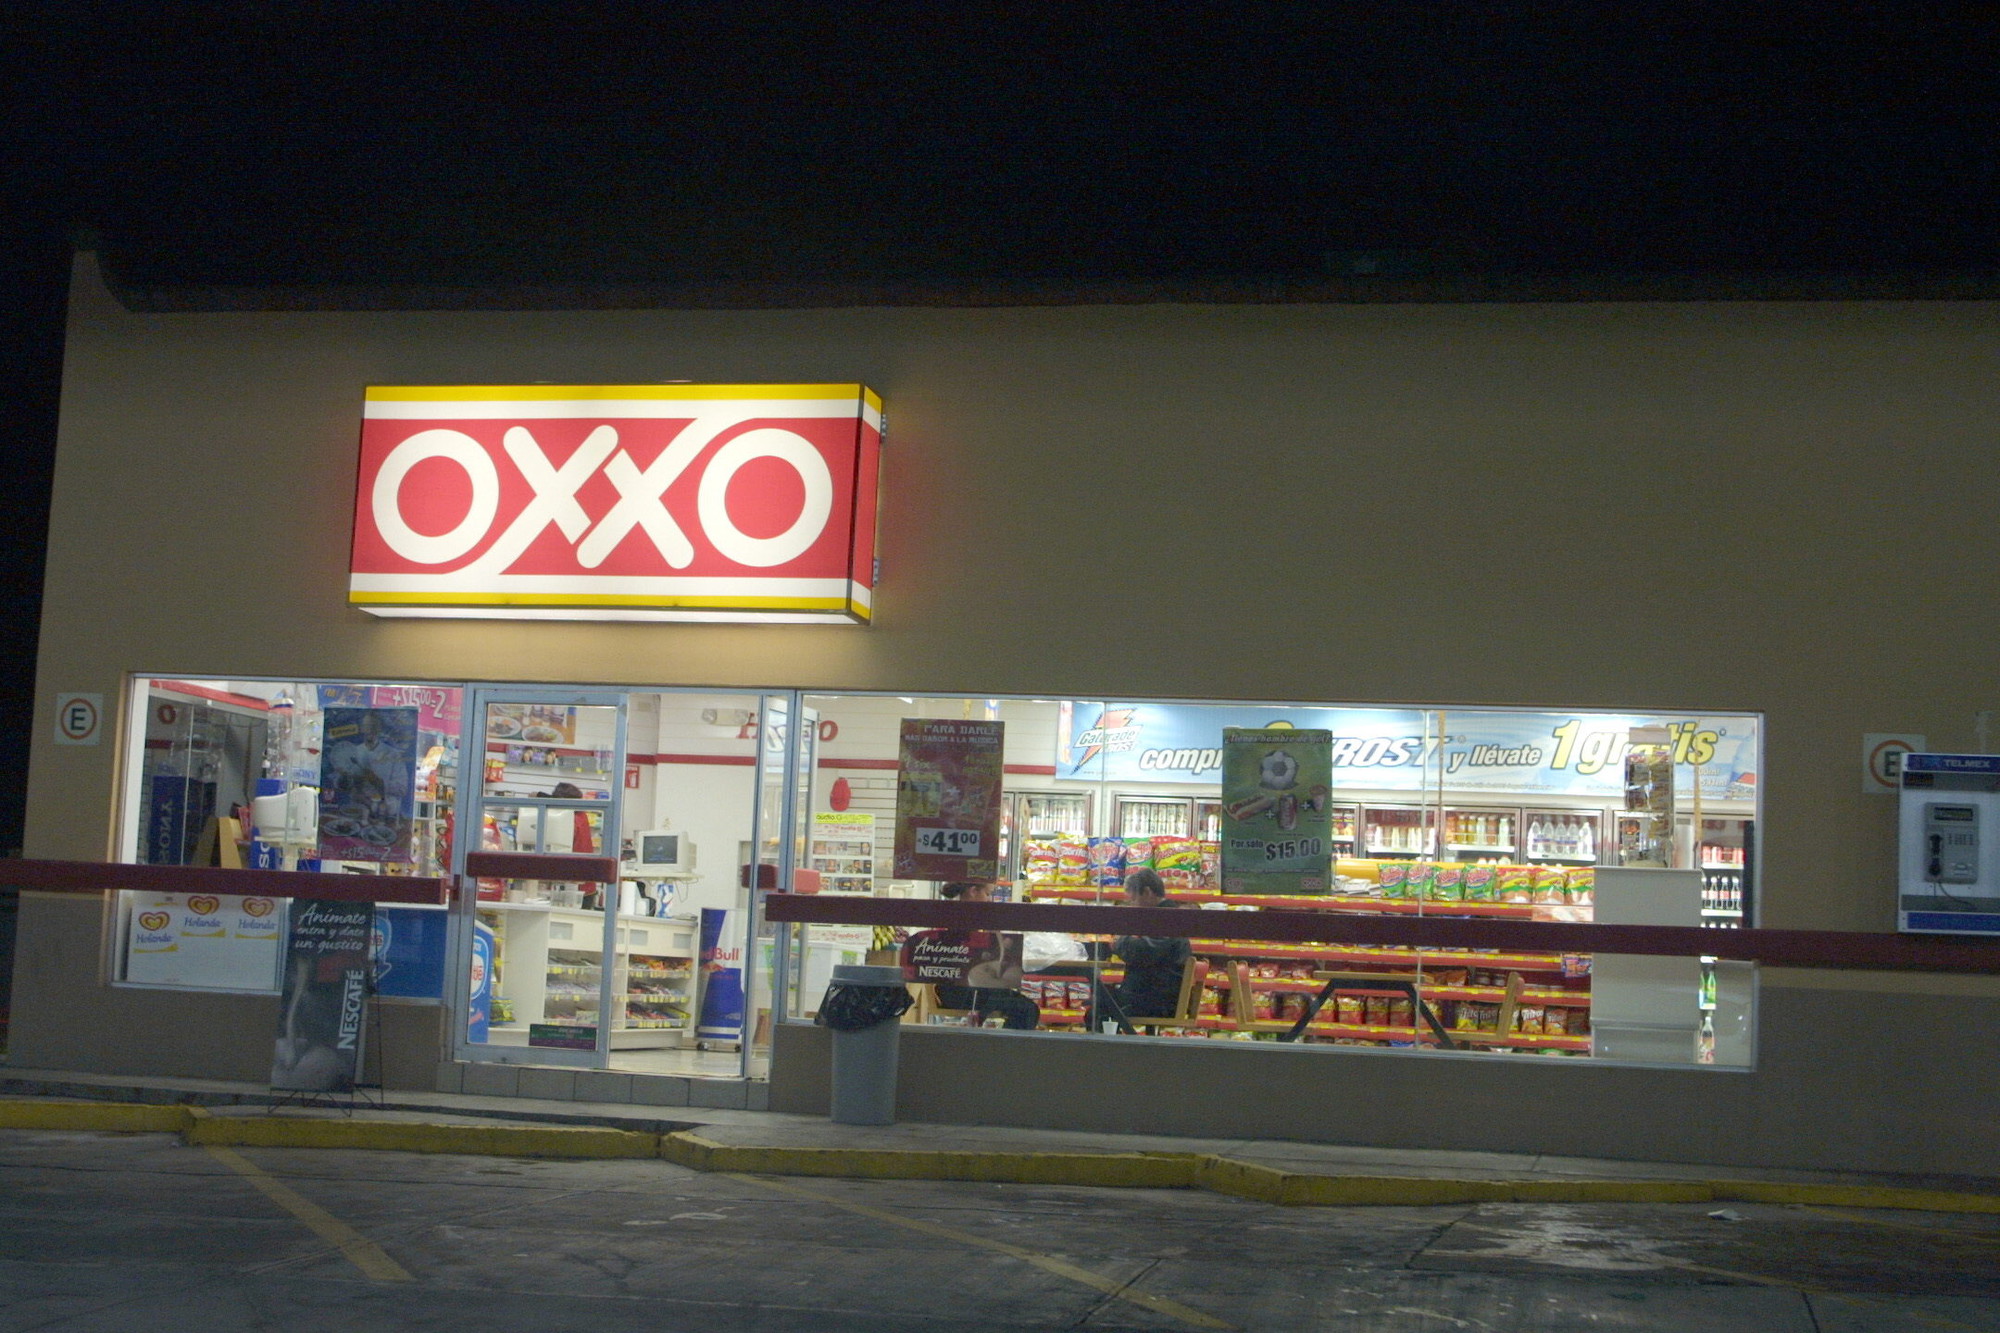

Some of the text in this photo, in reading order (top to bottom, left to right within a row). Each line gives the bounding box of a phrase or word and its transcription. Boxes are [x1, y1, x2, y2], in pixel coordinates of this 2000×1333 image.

[372, 420, 832, 573] OXXO
[70, 709, 86, 734] E
[924, 724, 955, 734] PARA
[1079, 730, 1136, 745] Gatorade
[1332, 735, 1452, 767] ROST
[1446, 751, 1467, 773] y
[1469, 743, 1542, 767] llévate
[1550, 719, 1581, 770] 1
[1943, 758, 1991, 769] TELMEX
[1265, 838, 1321, 861] $15.00
[296, 926, 365, 939] entra y date
[294, 940, 314, 950] un
[317, 938, 365, 954] gustito
[918, 966, 962, 979] NESCAFÉ
[338, 969, 364, 1050] NESCAFÉ
